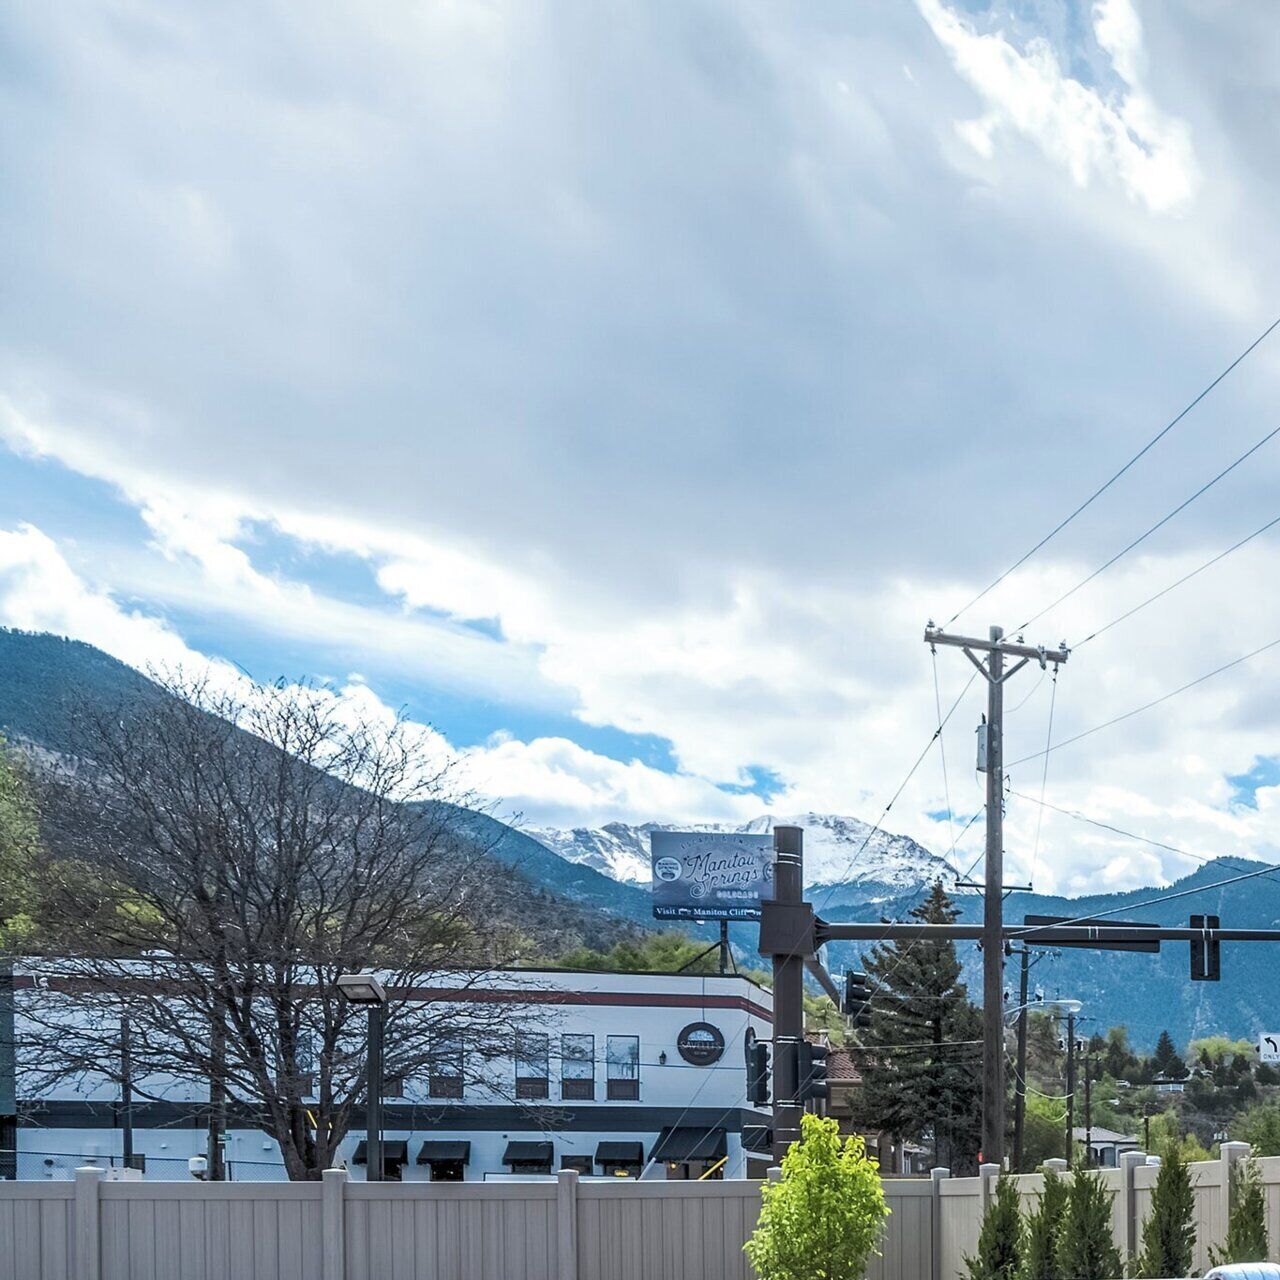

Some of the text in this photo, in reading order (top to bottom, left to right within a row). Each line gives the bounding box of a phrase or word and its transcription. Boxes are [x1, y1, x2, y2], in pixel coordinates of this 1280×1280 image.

[686, 851, 755, 879] Manitou
[689, 867, 759, 898] Springs
[656, 907, 676, 915] Visit
[693, 908, 728, 916] Manitou
